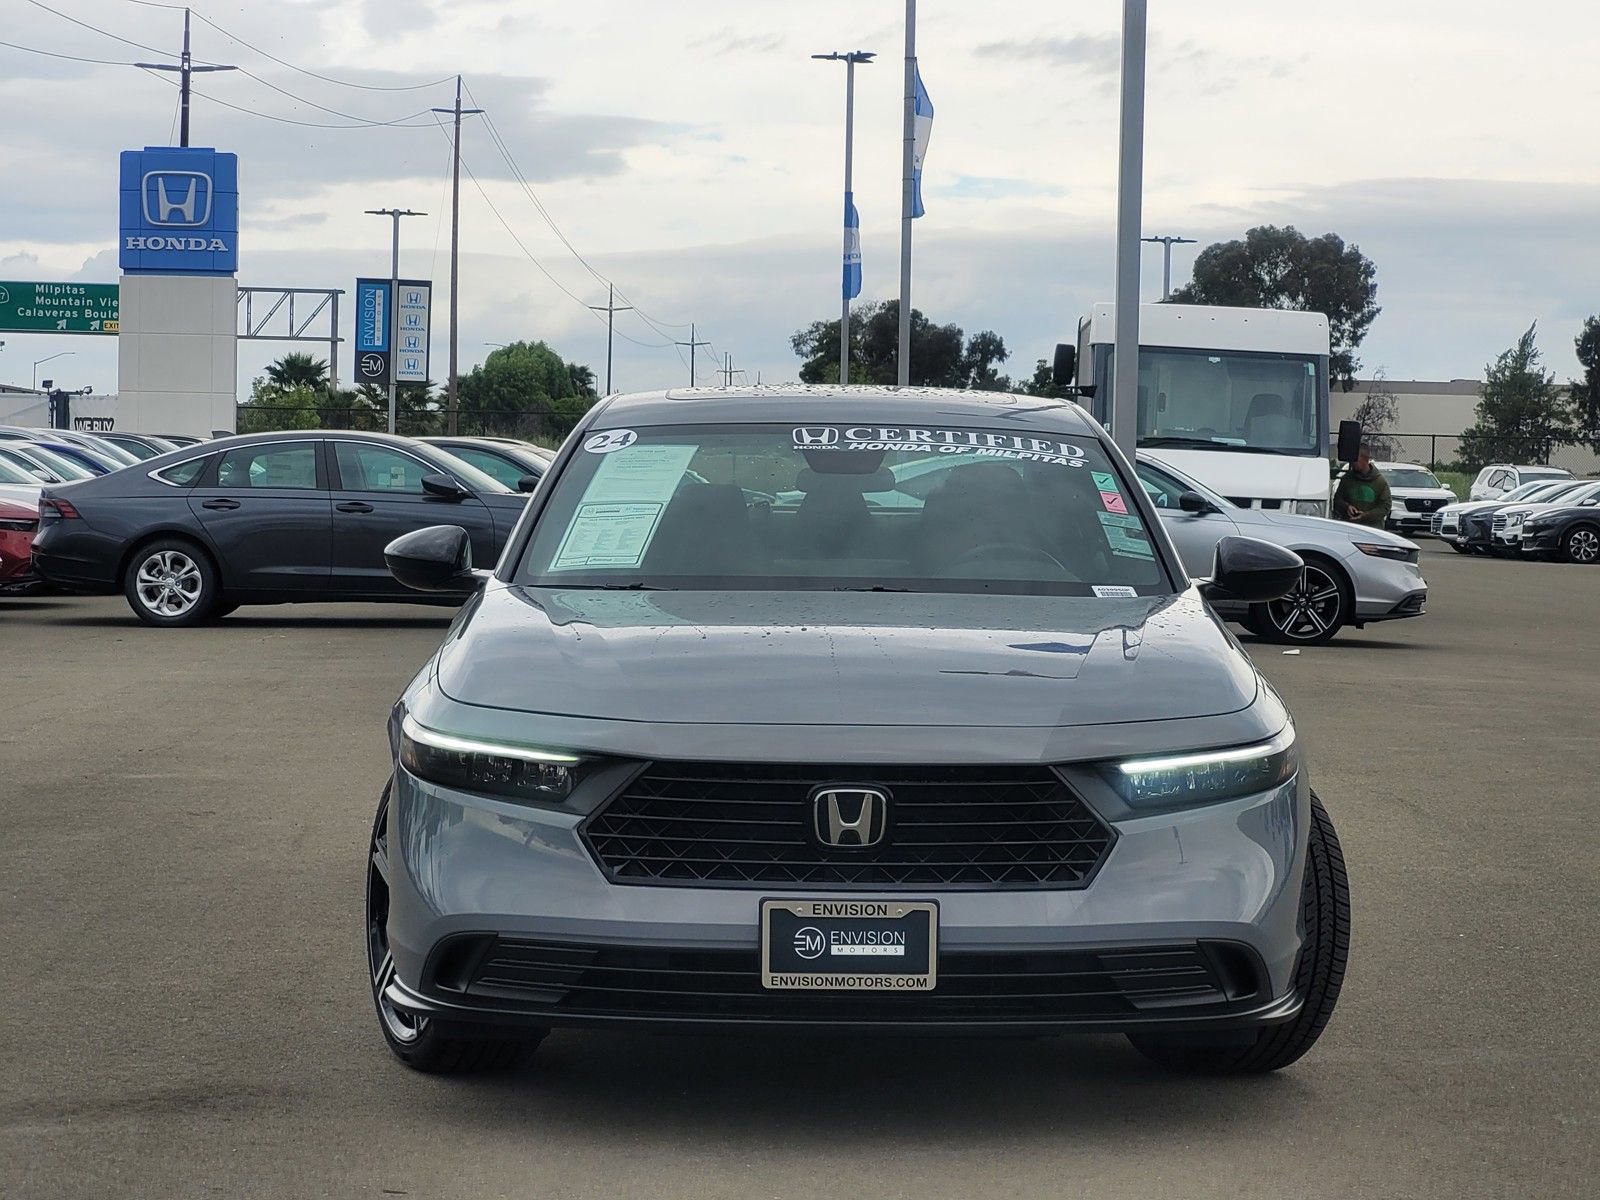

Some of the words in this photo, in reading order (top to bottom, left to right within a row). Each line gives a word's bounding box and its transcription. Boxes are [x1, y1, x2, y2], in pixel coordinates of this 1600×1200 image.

[126, 236, 228, 251] HONDA
[35, 284, 86, 296] Milpitas
[35, 296, 93, 307] Mountain
[100, 297, 119, 307] Vie
[17, 307, 79, 318] Calaveras
[84, 309, 119, 319] Boule
[363, 288, 375, 346] ENVISION
[588, 431, 632, 450] 24
[845, 427, 1085, 458] CERTIFIED
[848, 442, 932, 452] HONDA
[938, 445, 971, 454] OF
[975, 448, 1084, 468] MILPITAS
[812, 903, 888, 916] ENVISION
[830, 930, 906, 945] ENVISION
[836, 946, 899, 954] MOTORS
[770, 976, 928, 988] ENVISIONMOTORS.COM
